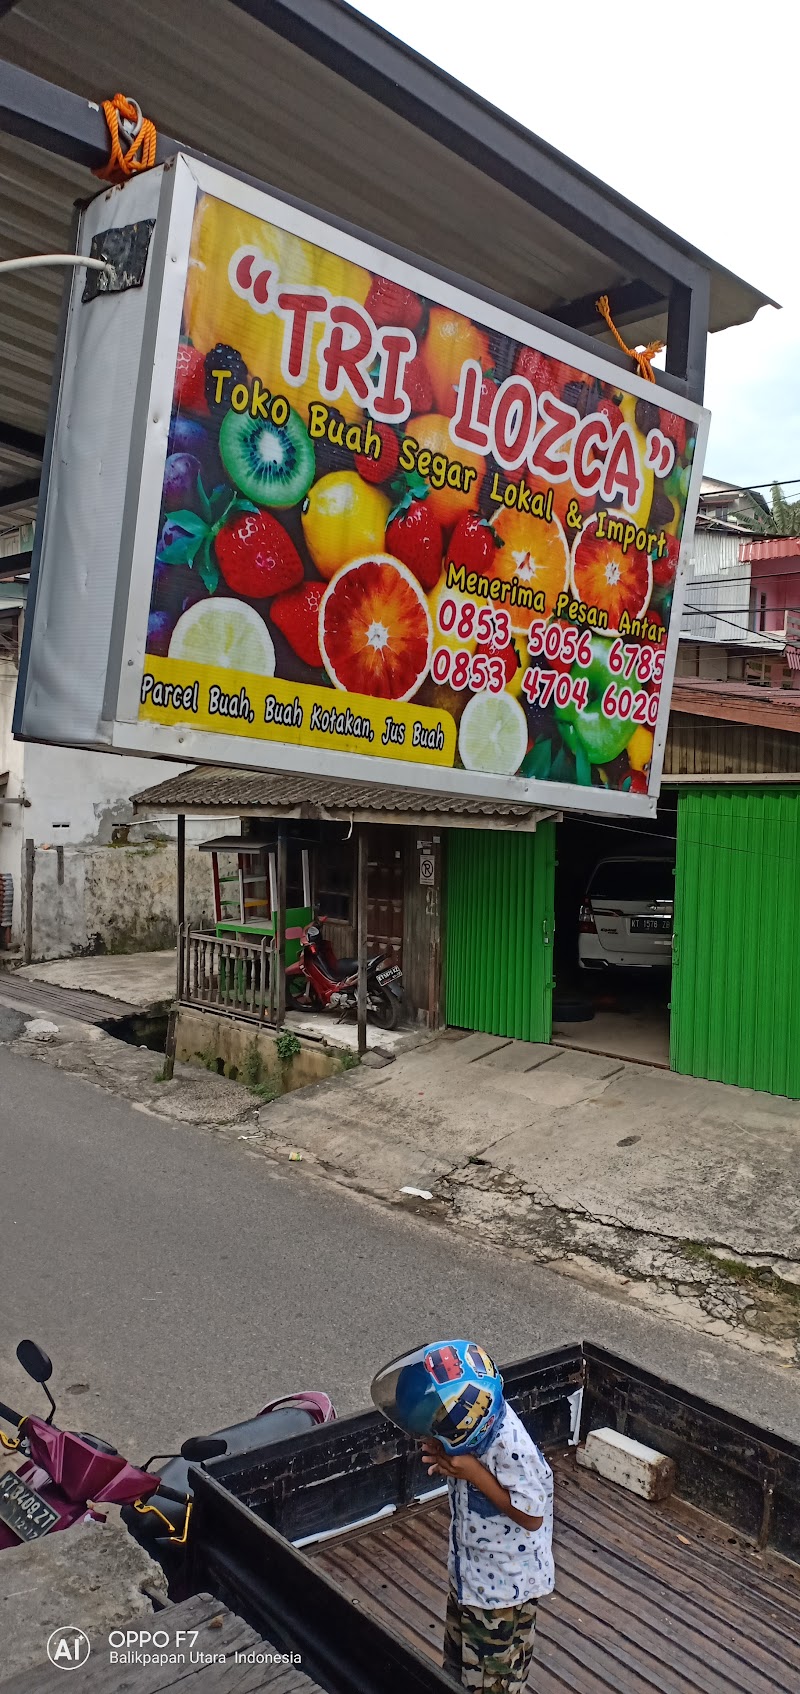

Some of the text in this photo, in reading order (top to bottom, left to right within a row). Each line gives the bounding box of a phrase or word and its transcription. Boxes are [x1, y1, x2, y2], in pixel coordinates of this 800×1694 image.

[211, 369, 667, 556] Toko Buah Segar Lokal & Import
[438, 599, 666, 684] 0853 5056 6785
[447, 563, 666, 643] Menerima Pesan Antar
[140, 673, 445, 751] Parcel Buah, Buah Kotakan, Jus Buah
[432, 648, 660, 725] 0853 4704 6020
[33, 1508, 56, 1527] ZT
